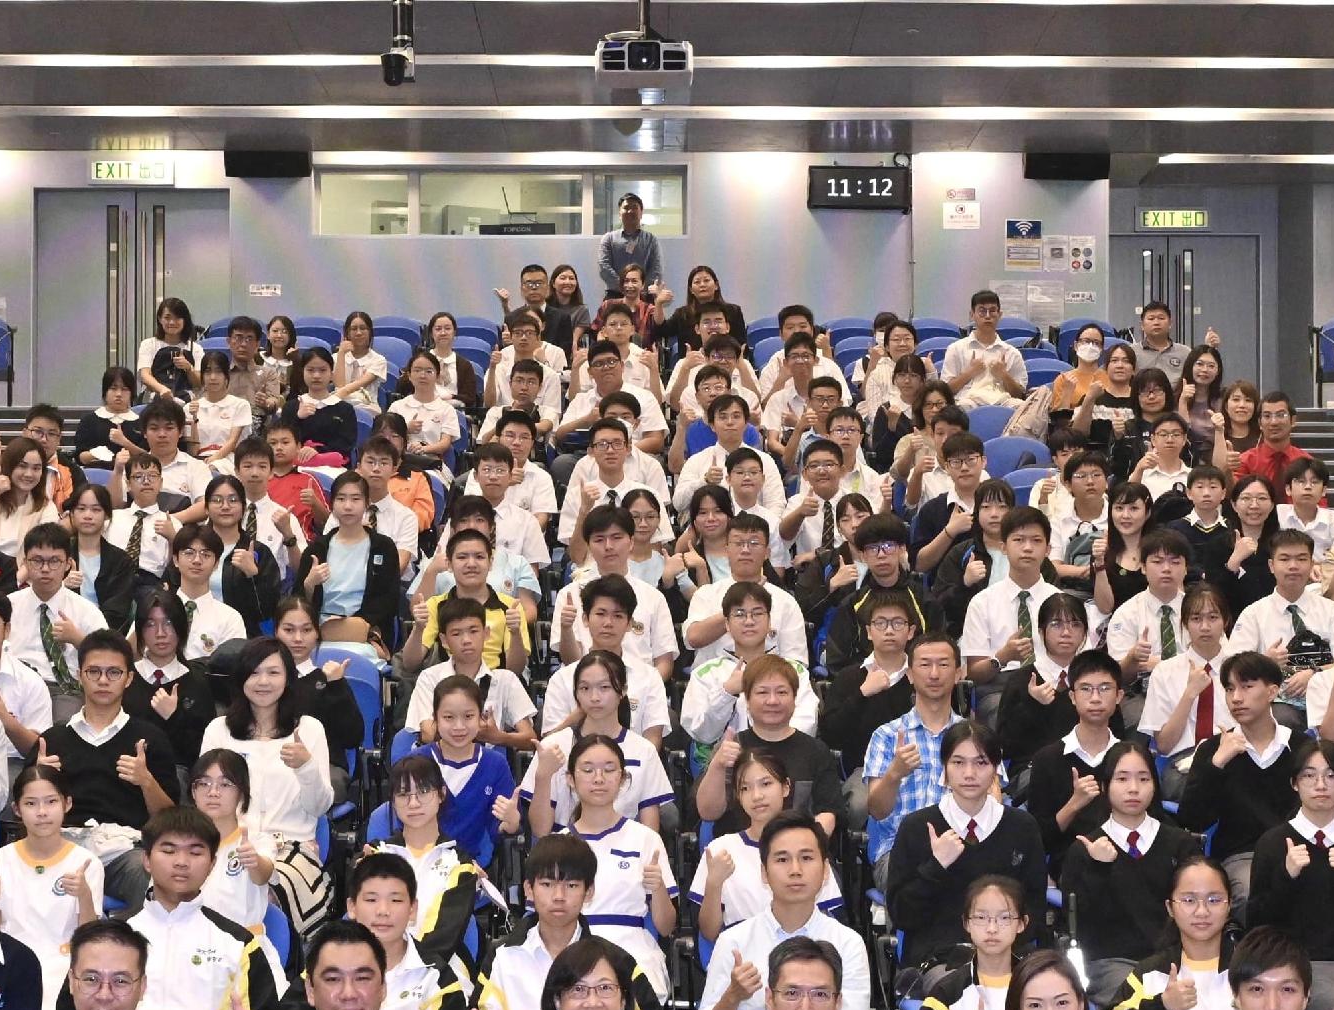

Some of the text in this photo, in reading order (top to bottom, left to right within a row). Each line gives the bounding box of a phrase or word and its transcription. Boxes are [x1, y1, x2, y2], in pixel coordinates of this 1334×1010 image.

[95, 162, 131, 178] EXIT
[827, 177, 893, 197] 11:12
[1142, 211, 1205, 226] EXIT 出口
